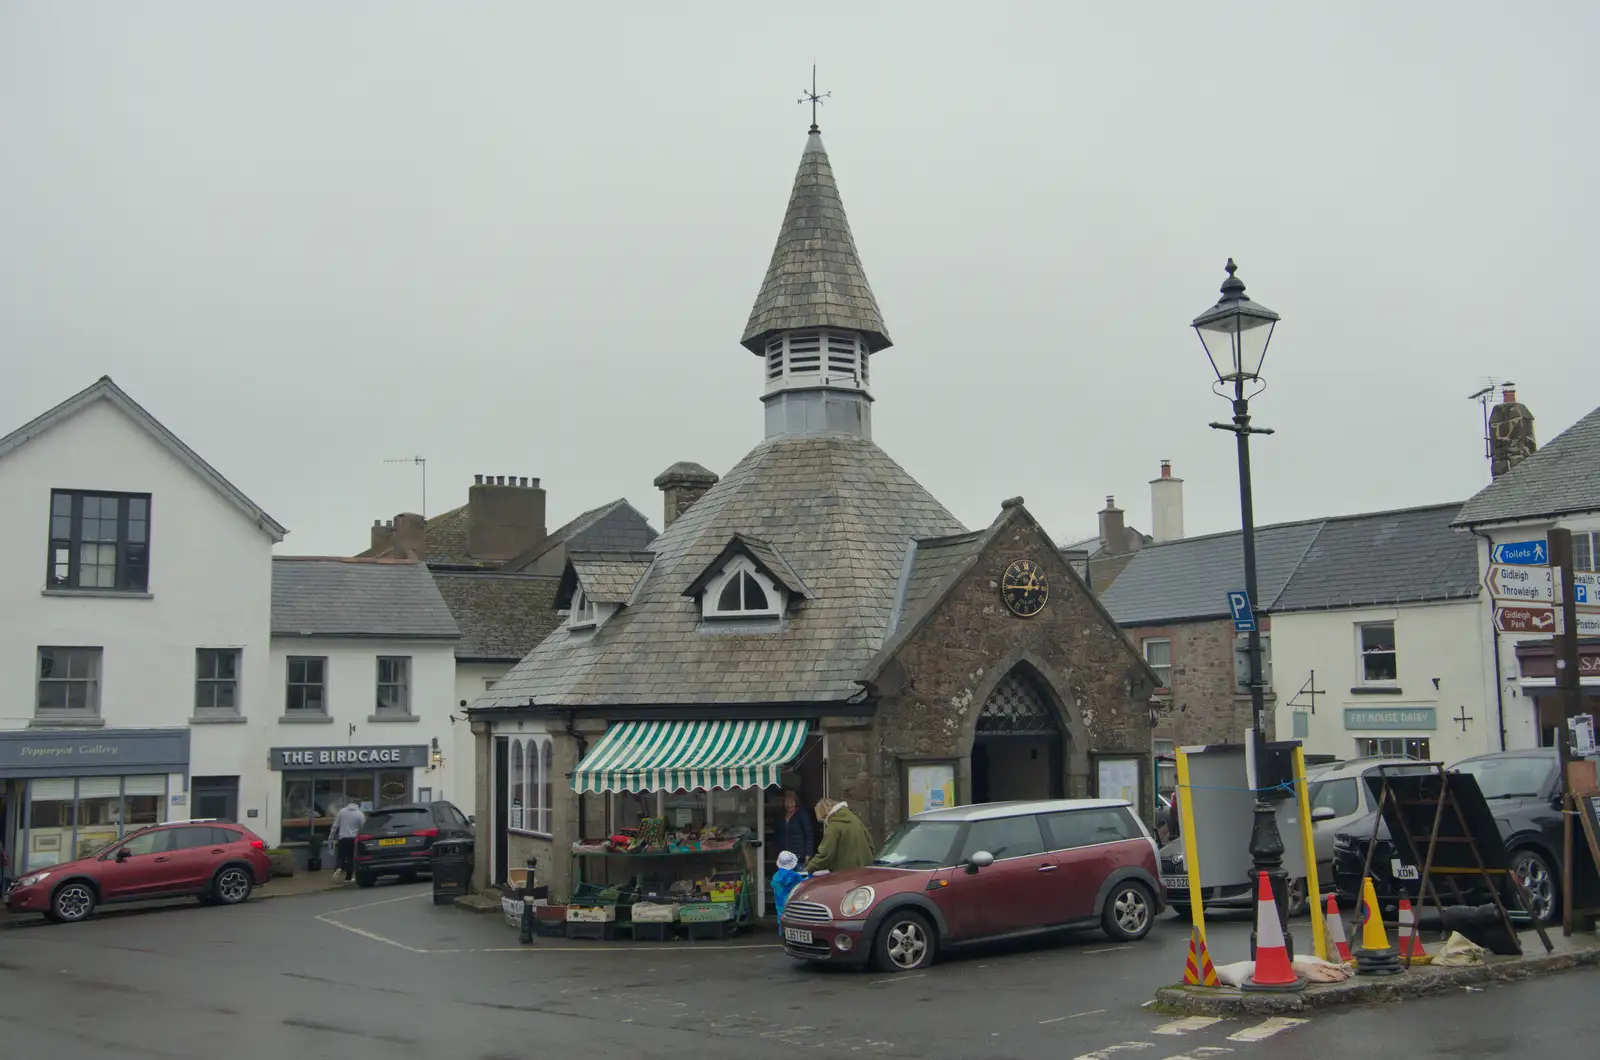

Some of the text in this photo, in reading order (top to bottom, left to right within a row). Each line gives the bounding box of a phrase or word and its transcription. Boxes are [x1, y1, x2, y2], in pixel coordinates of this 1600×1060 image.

[1504, 549, 1531, 559] Toilets
[1501, 568, 1551, 582] Gidleigh 2
[1574, 574, 1595, 585] Health
[1502, 585, 1552, 598] Throwleigh 3
[1577, 587, 1585, 601] P
[1230, 593, 1246, 619] P
[1504, 610, 1531, 620] Gidleigh
[1511, 620, 1526, 628] Park
[1578, 656, 1600, 671] SA
[1351, 712, 1428, 723] FAT MOUSE DAIRY
[78, 744, 119, 755] Gallery
[282, 749, 400, 764] THE BIRDCAGE
